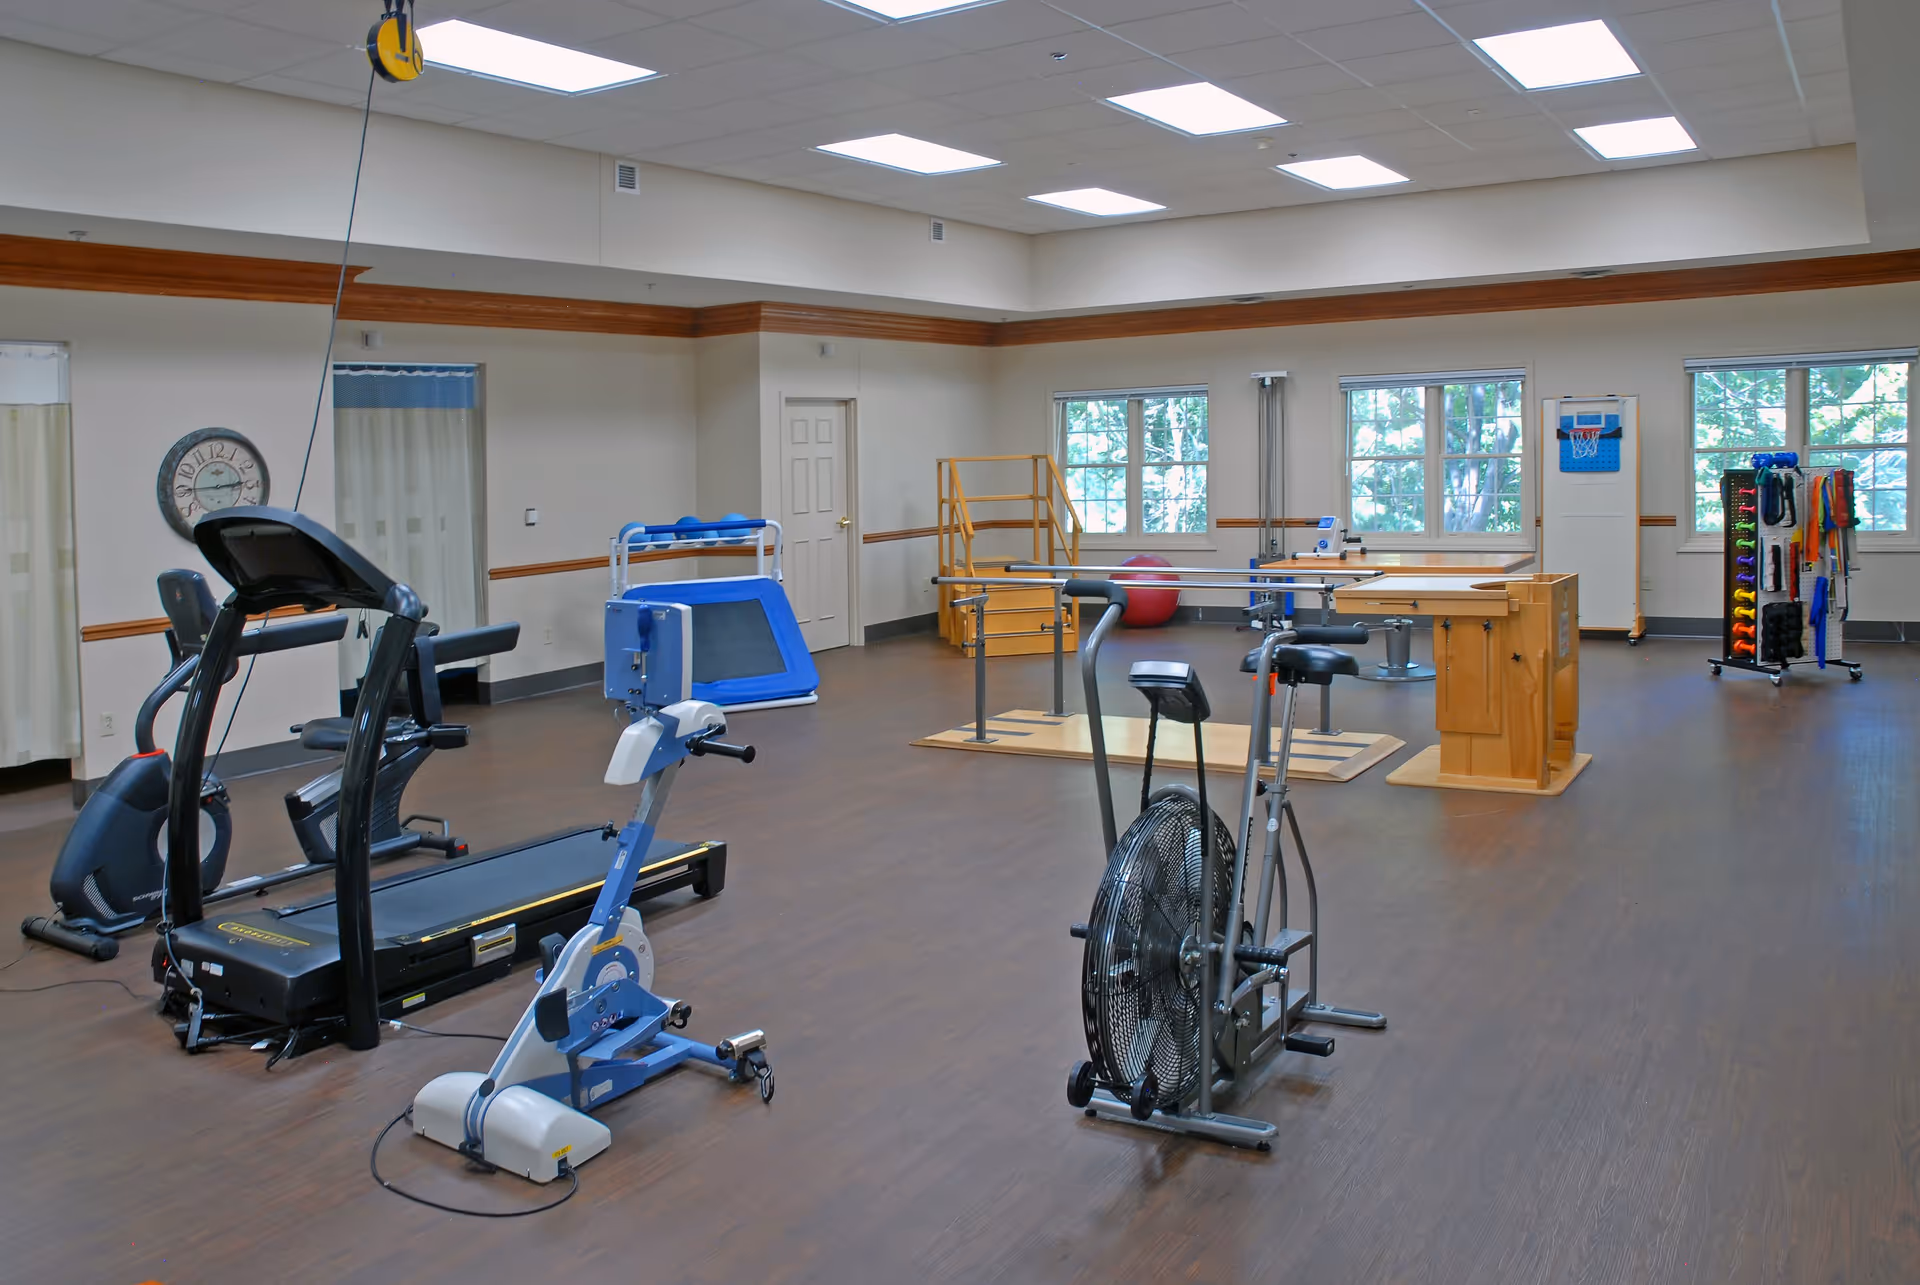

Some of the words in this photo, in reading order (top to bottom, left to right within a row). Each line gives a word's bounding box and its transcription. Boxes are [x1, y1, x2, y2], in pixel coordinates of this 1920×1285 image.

[193, 450, 206, 467] 11
[209, 442, 227, 460] 12
[230, 447, 238, 462] 1
[178, 463, 195, 479] 10
[239, 460, 254, 475] 2
[175, 484, 192, 498] 9
[244, 479, 260, 491] 3
